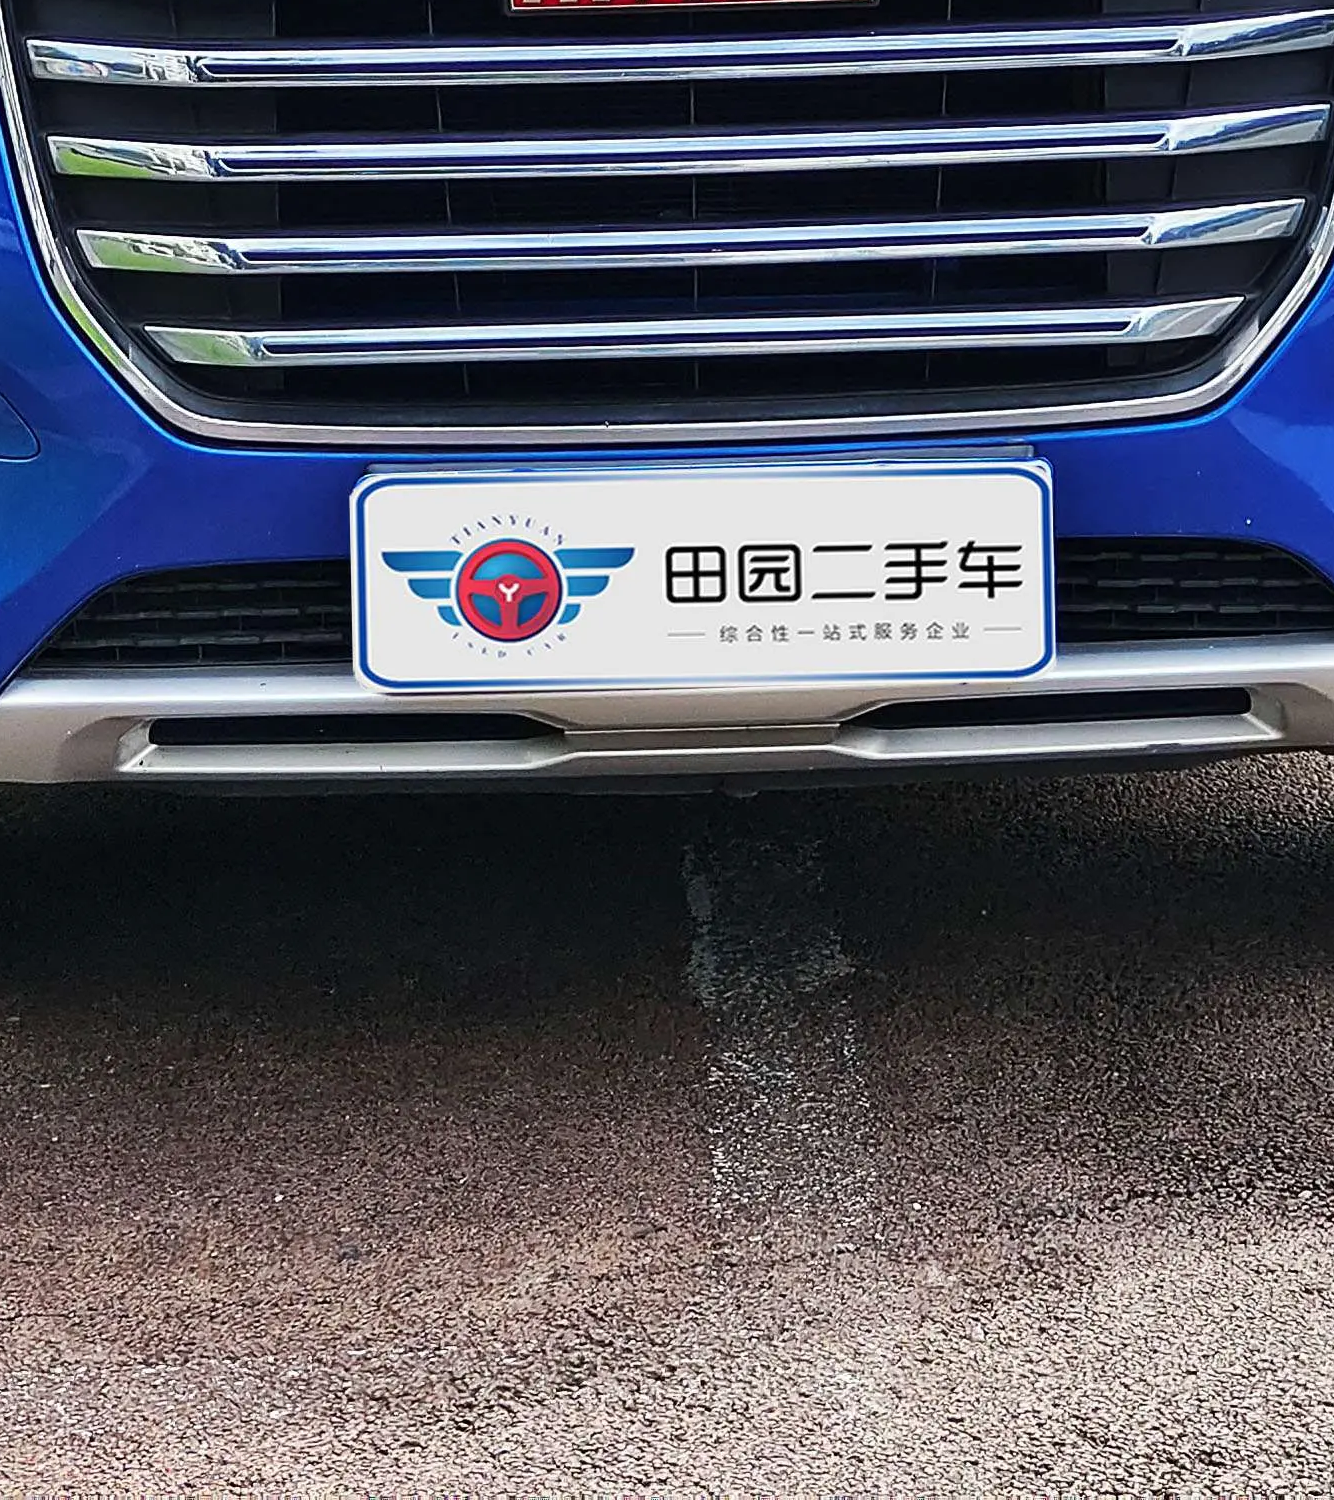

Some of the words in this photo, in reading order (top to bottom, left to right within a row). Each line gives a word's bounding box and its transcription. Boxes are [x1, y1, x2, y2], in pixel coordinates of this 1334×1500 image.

[665, 540, 1023, 603] 田园二手车
[719, 621, 971, 644] 综合性一站式服务企业
